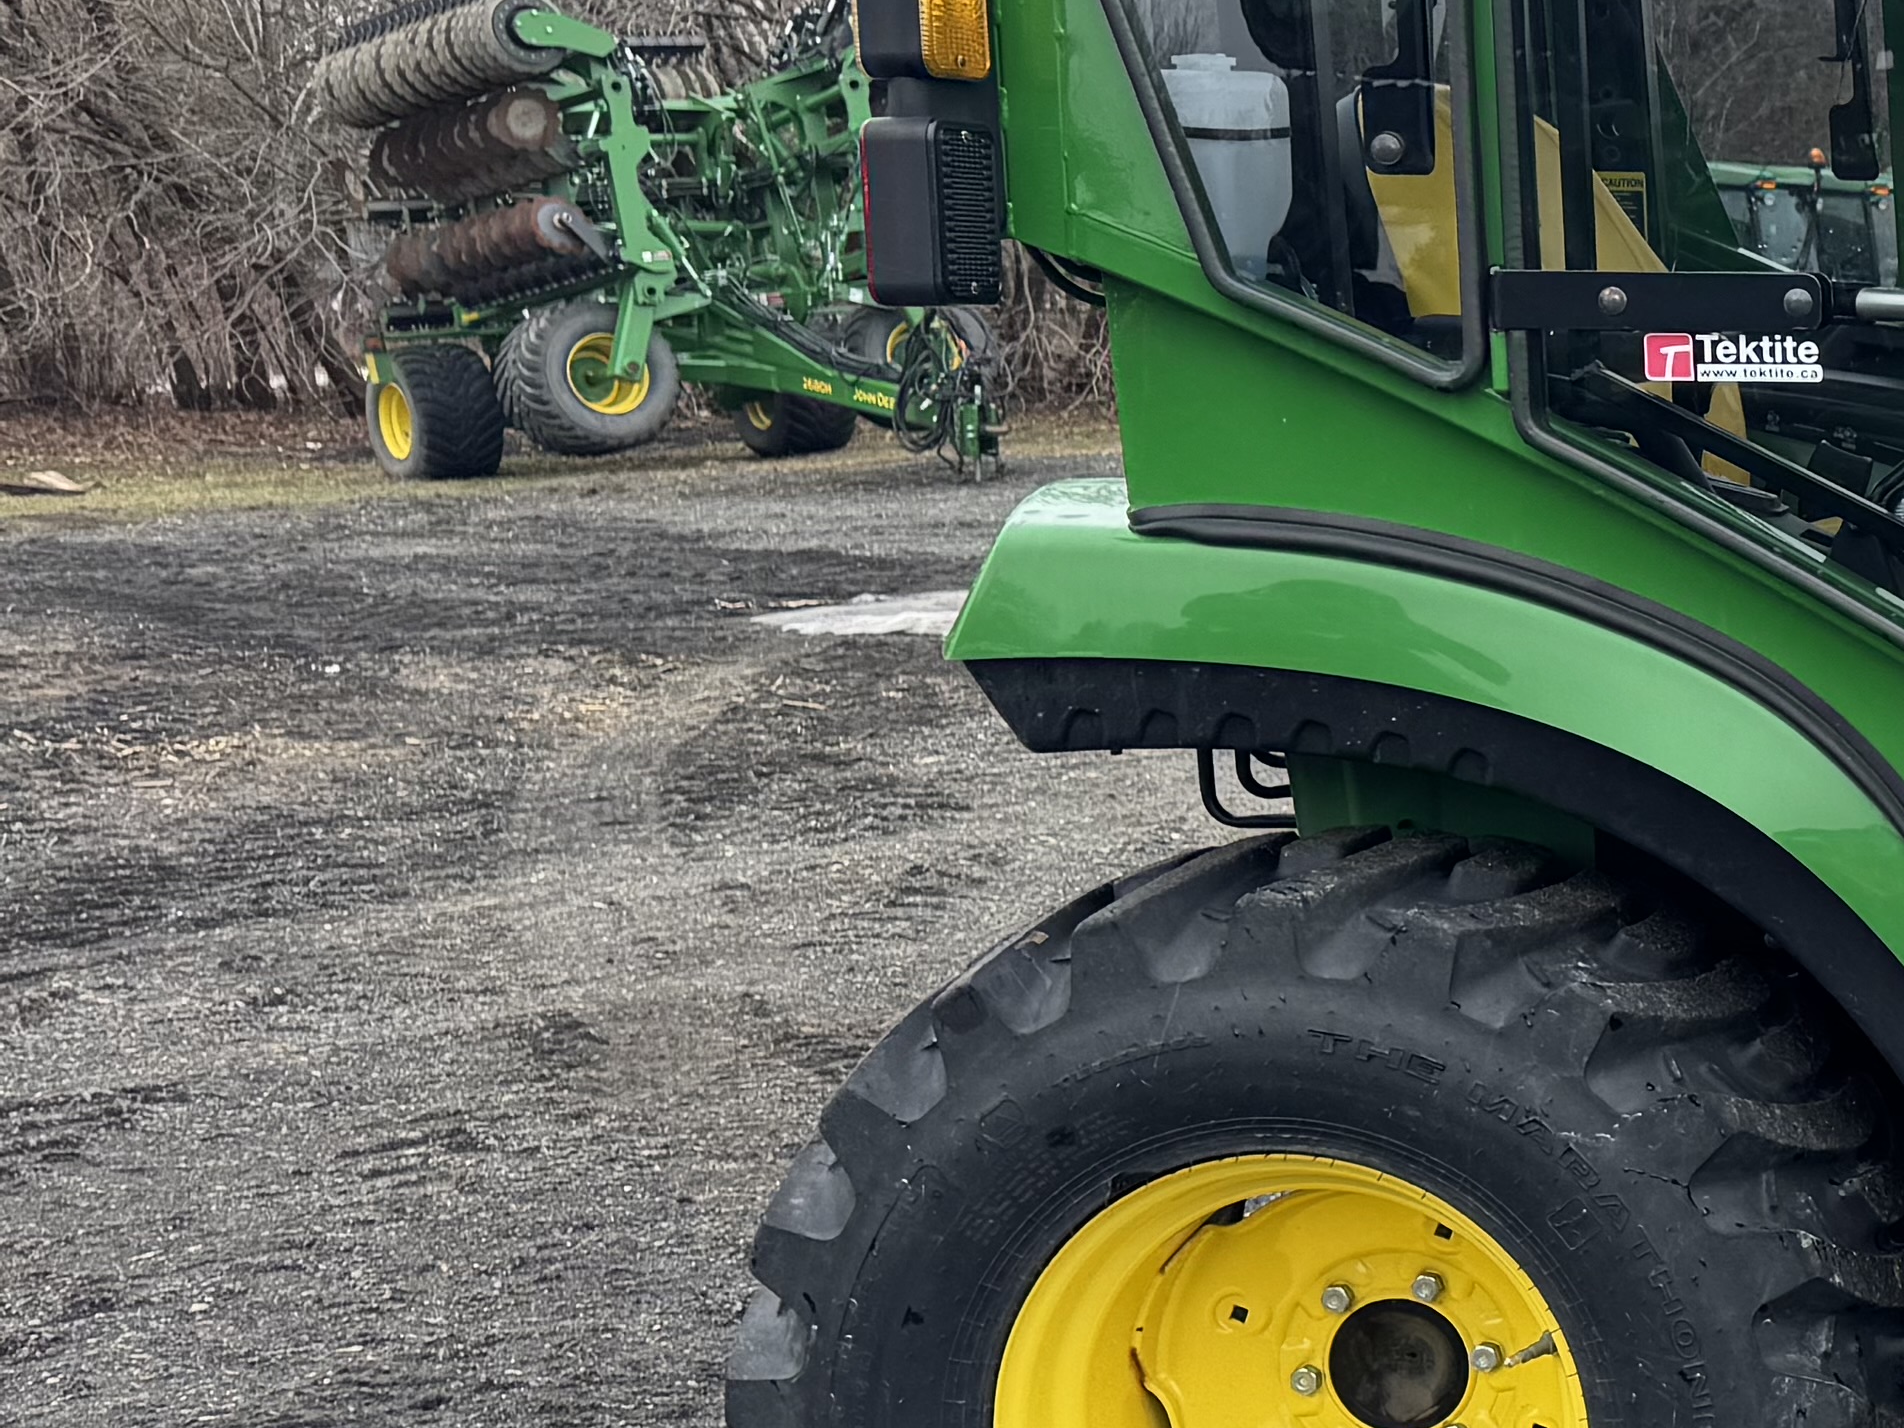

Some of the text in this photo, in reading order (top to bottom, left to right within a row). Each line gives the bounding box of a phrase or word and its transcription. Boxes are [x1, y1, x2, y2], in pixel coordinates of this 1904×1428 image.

[1695, 333, 1820, 364] Tektite
[1699, 367, 1818, 379] www.tektite.ca
[877, 392, 895, 410] DEE
